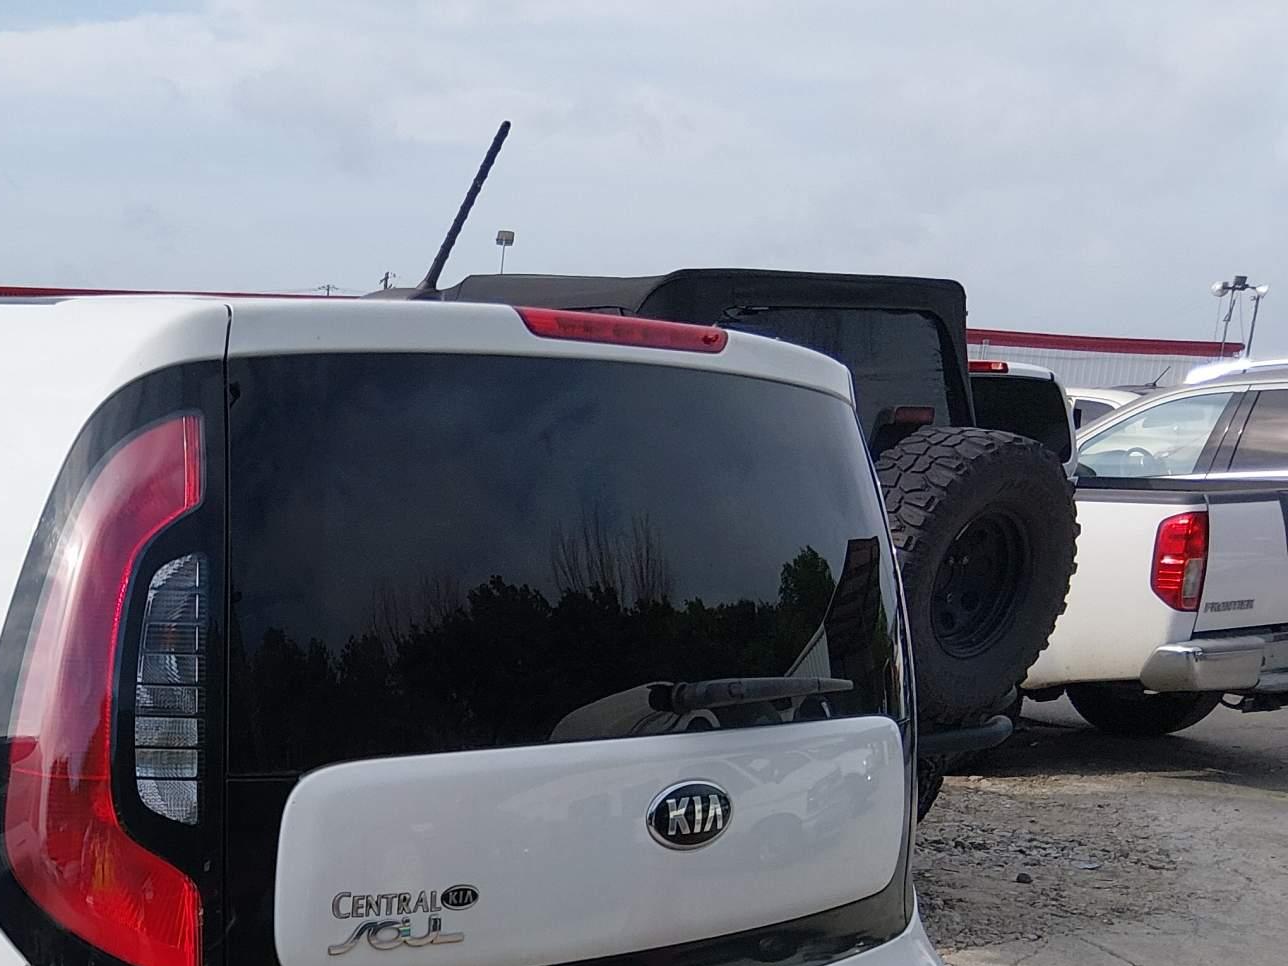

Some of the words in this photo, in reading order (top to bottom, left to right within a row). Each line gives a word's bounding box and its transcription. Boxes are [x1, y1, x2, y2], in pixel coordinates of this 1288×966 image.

[1204, 599, 1255, 613] FRONTIER
[665, 794, 724, 836] KIA
[331, 890, 442, 920] CENTRAL
[447, 889, 475, 906] KIA
